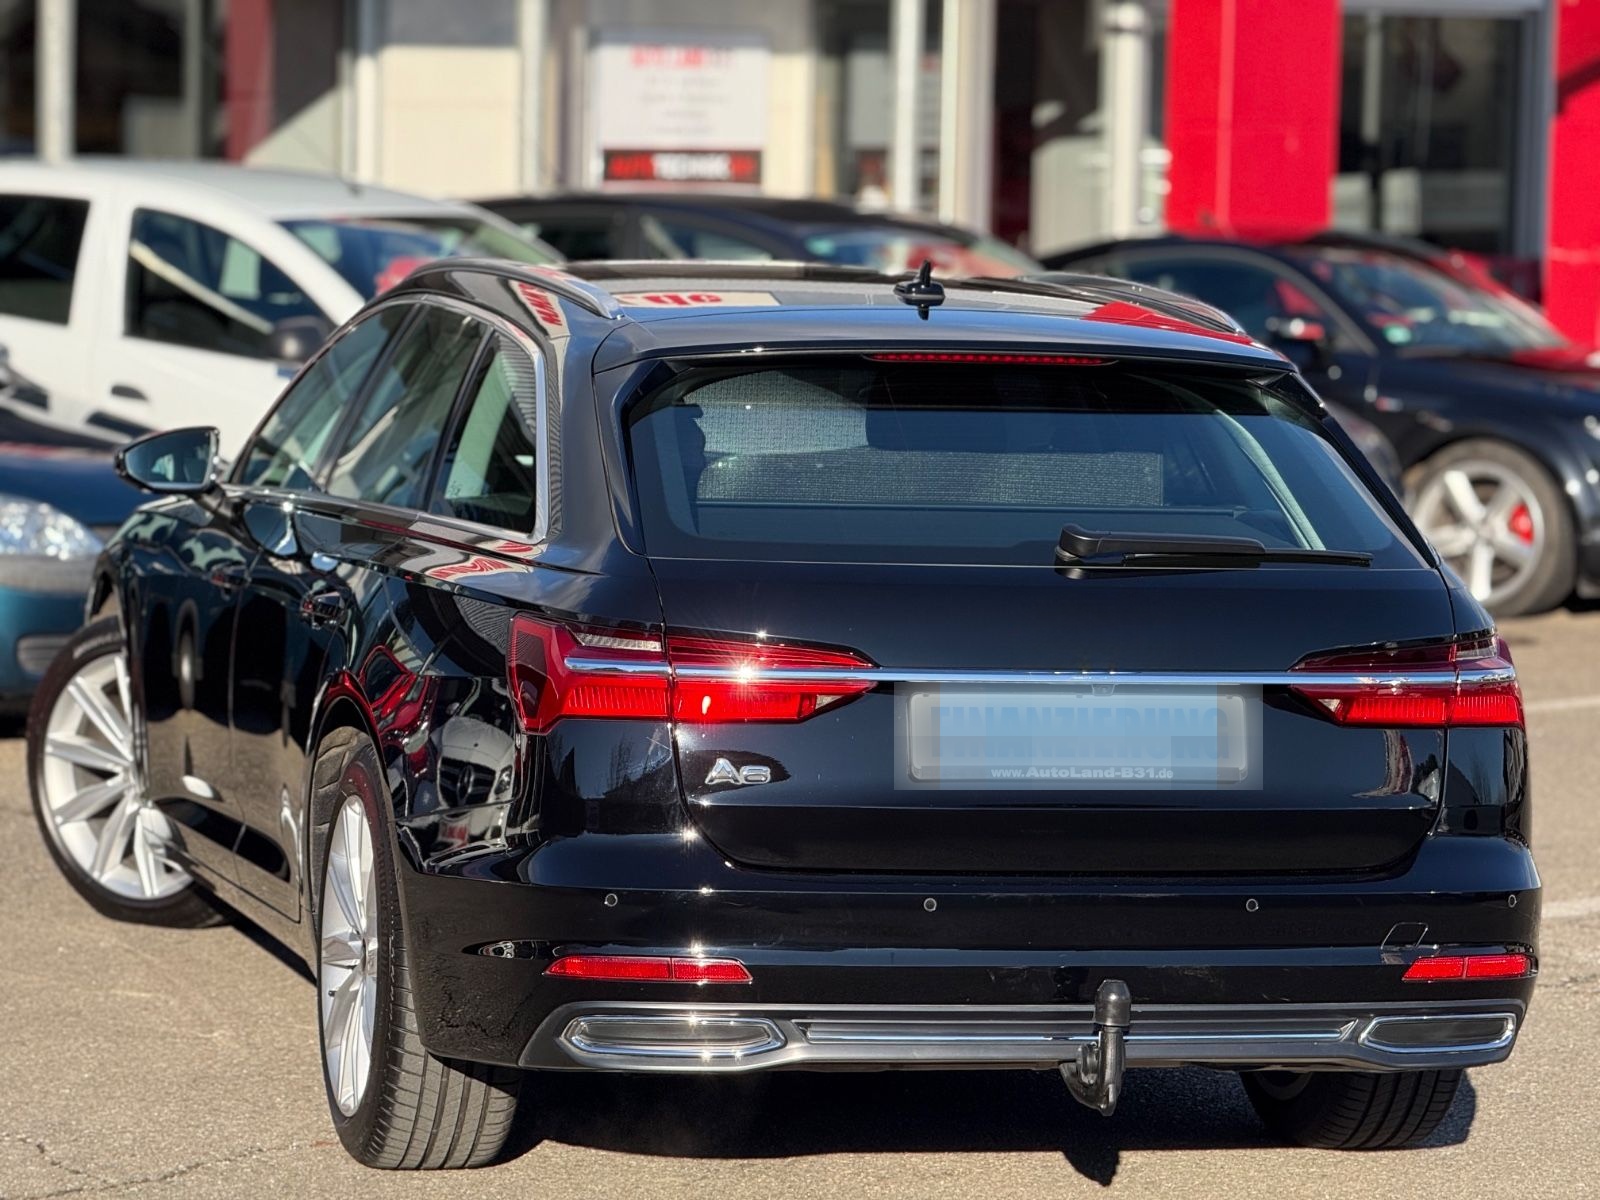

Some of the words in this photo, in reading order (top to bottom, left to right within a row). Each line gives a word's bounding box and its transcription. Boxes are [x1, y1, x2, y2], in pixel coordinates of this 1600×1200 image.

[930, 705, 1230, 760] FINANZIERUNG
[704, 757, 771, 785] A6
[990, 766, 1174, 780] www.AutoLand-B31.de
